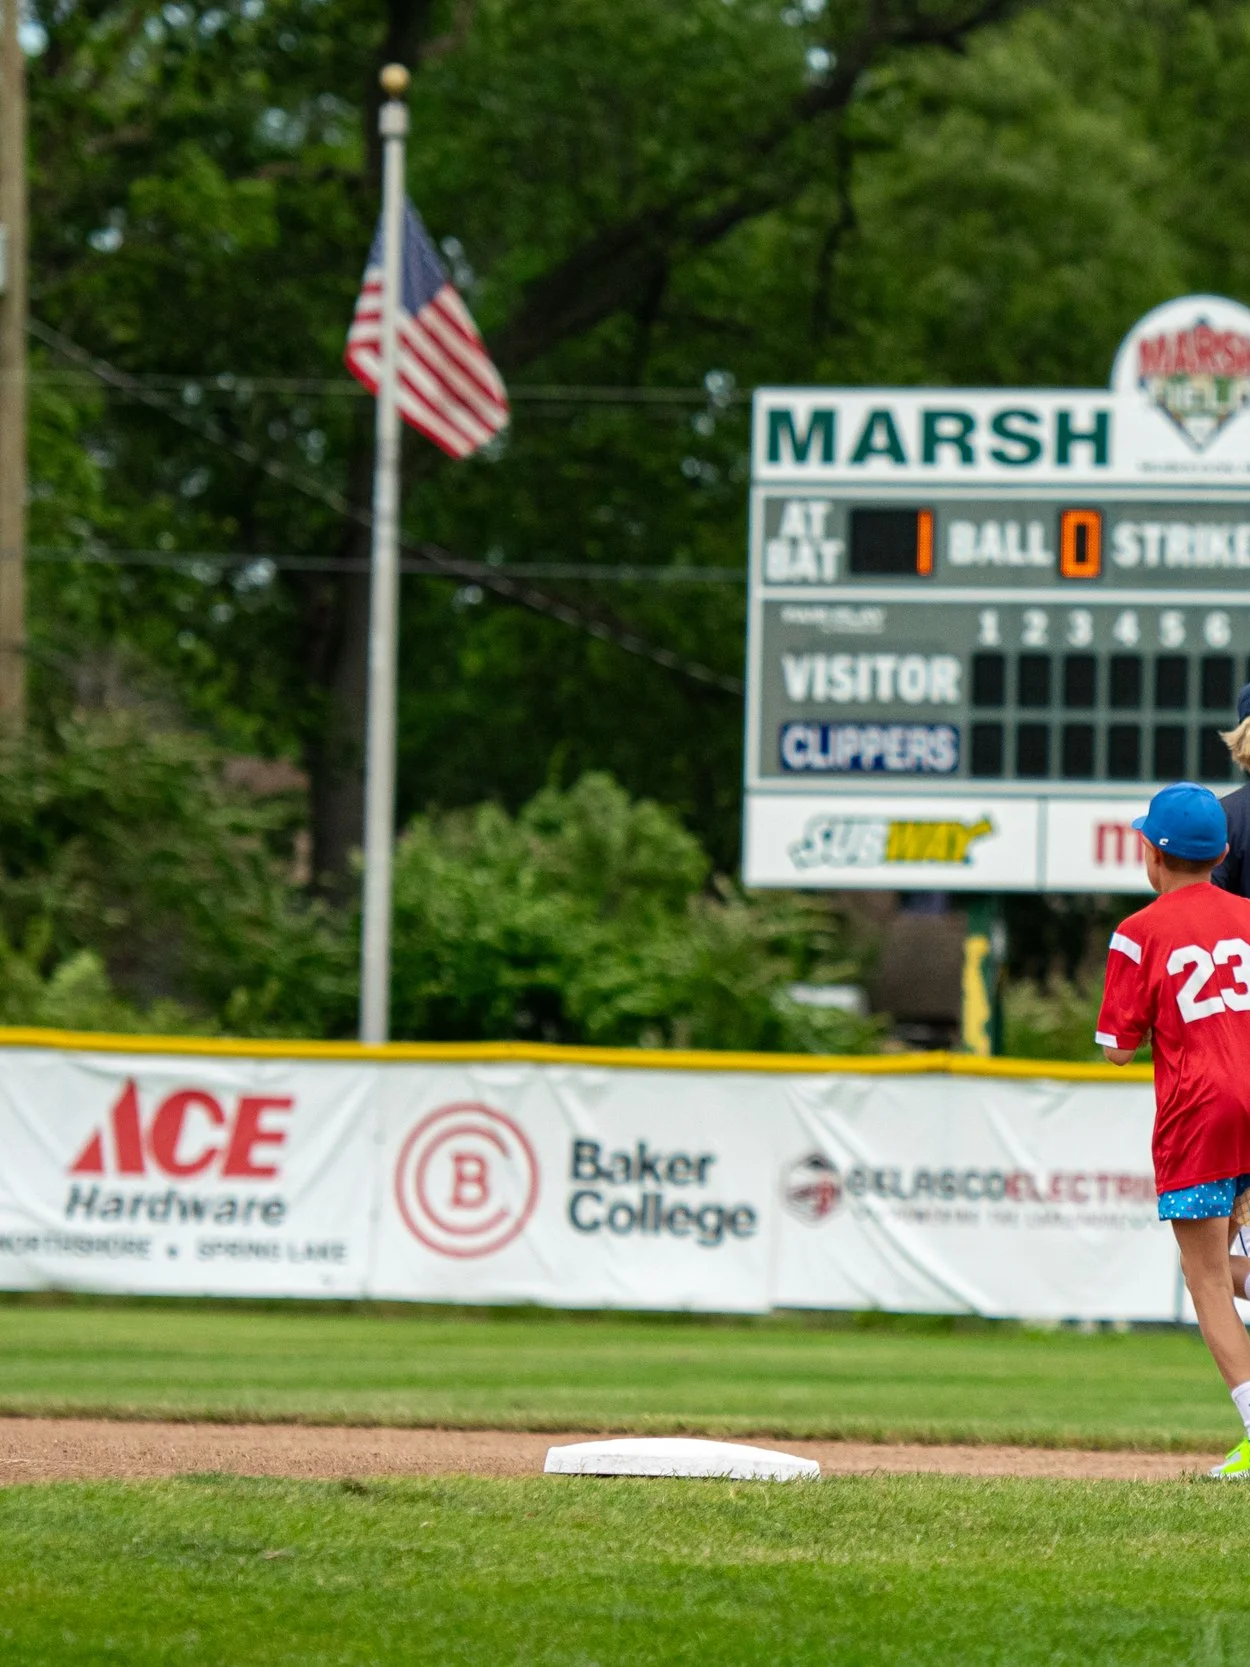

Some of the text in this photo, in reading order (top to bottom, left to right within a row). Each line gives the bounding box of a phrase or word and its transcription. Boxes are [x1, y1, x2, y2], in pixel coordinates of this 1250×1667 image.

[767, 408, 1111, 467] MARSH
[779, 500, 831, 537] AT
[948, 521, 1053, 565] BALL
[1060, 509, 1102, 578] 0
[766, 540, 841, 582] BAT
[980, 610, 1000, 646] 1
[1022, 610, 1049, 646] 2
[1068, 611, 1093, 647] 3
[1114, 611, 1140, 647] 4
[1160, 611, 1186, 647] 5
[1204, 611, 1231, 648] 6
[783, 653, 961, 704] VISITOR
[782, 724, 958, 770] CLIPPERS
[787, 811, 995, 870] SUBWAY
[66, 1075, 296, 1180] ACE
[571, 1137, 717, 1187] Baker
[65, 1183, 287, 1227] Hardware
[568, 1189, 758, 1248] College
